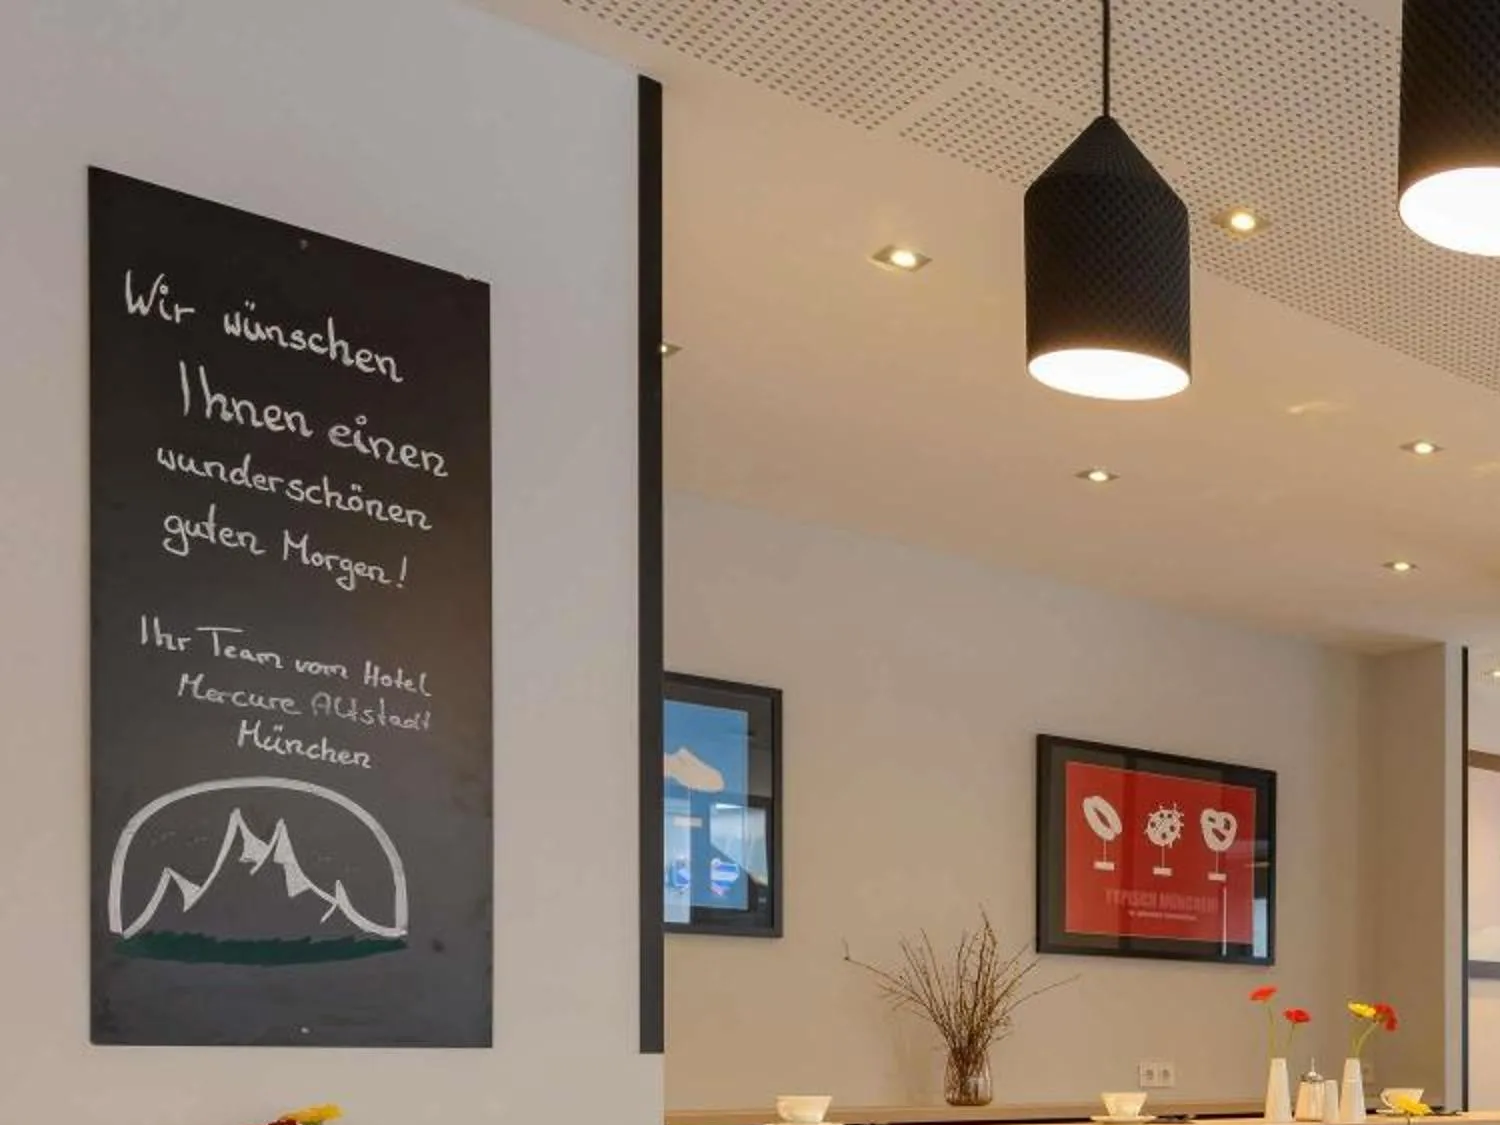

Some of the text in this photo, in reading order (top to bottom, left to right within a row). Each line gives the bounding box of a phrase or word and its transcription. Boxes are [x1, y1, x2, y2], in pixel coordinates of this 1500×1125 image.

[125, 269, 403, 383] Wir wünschen
[179, 359, 448, 477] Ihnen einen
[156, 447, 432, 530] wunderschönen
[163, 503, 407, 590] guten Morgen!
[141, 615, 432, 697] Ihr Team vom Hotel
[178, 674, 301, 715] Mercure
[237, 719, 372, 768] München
